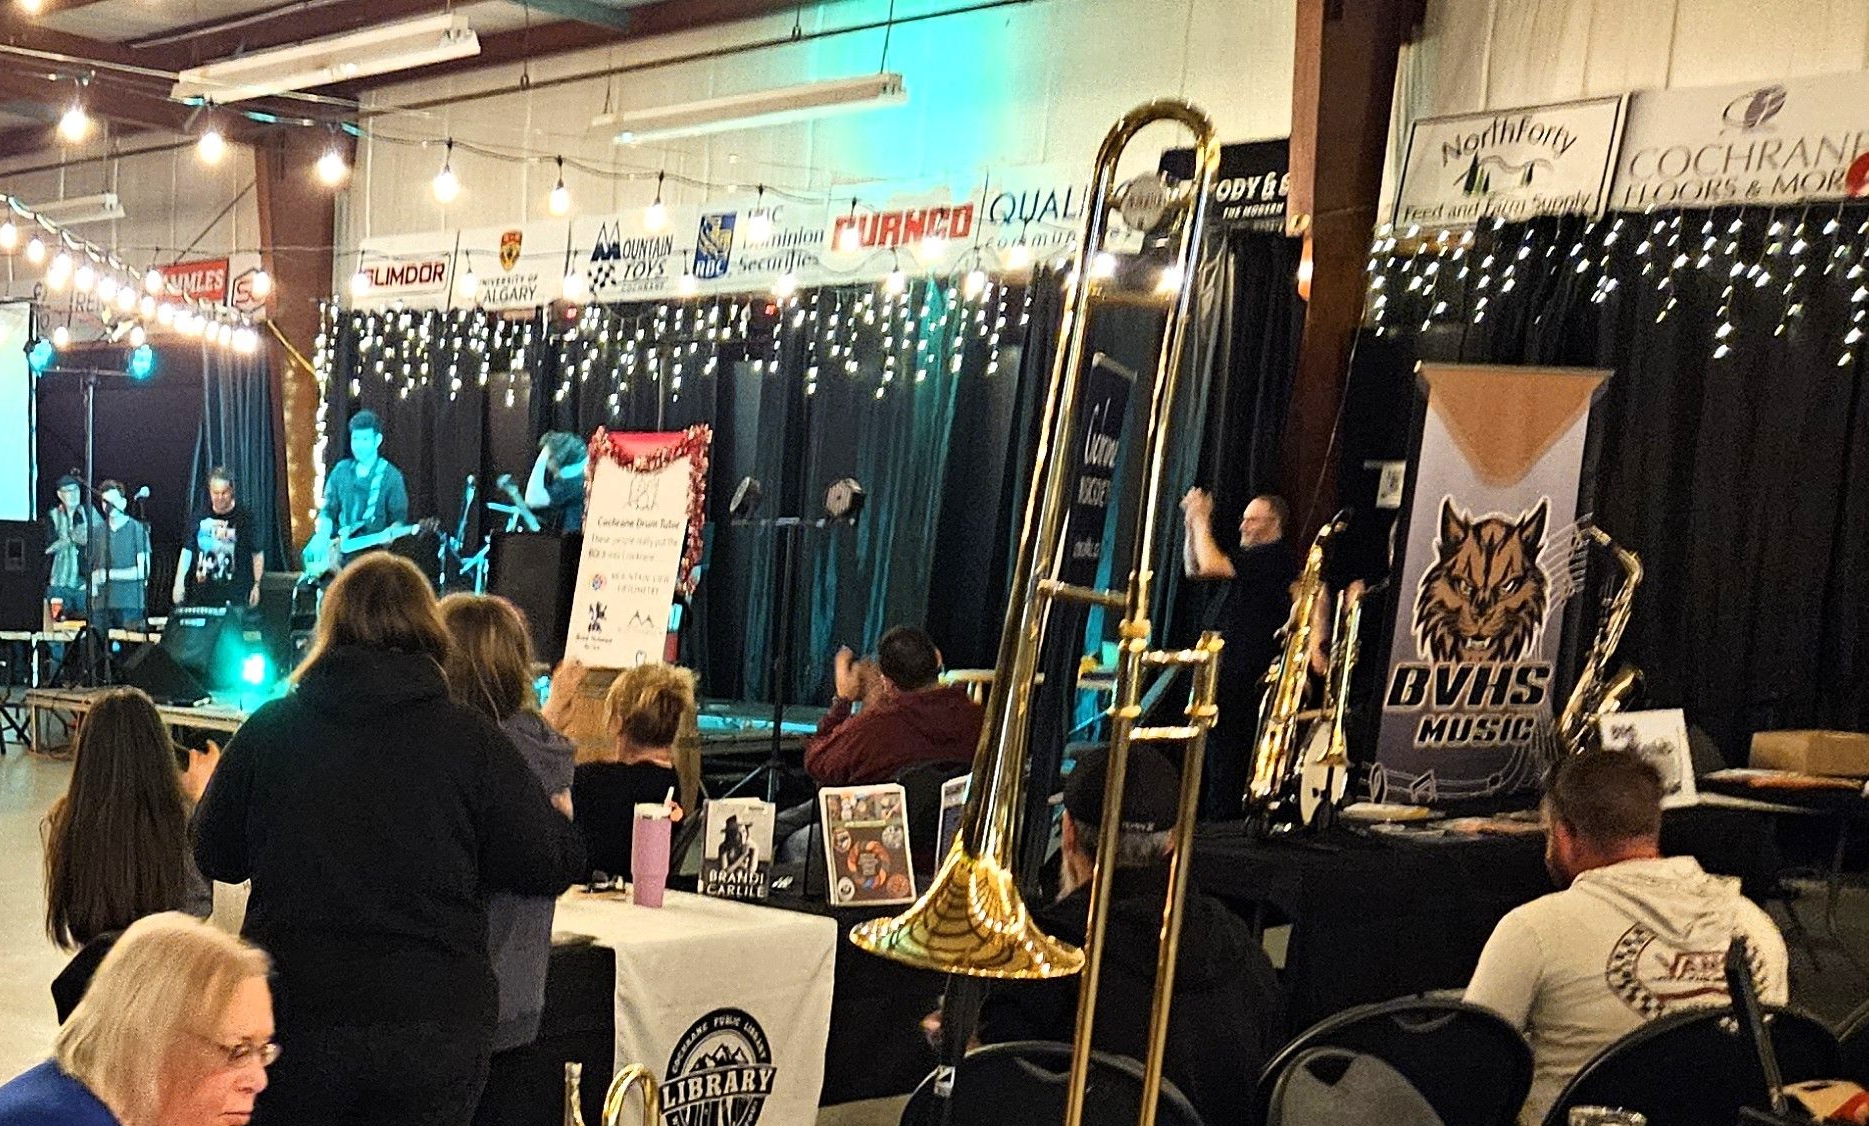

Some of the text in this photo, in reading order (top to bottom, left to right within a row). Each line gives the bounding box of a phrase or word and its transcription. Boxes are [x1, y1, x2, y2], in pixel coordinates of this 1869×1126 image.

[1210, 176, 1263, 202] ODY
[1745, 181, 1762, 198] &
[1771, 168, 1846, 195] MOR
[989, 185, 1101, 223] QUALI
[1404, 204, 1442, 222] Feed
[1448, 201, 1479, 220] and
[1534, 190, 1591, 215] Supply
[479, 274, 525, 287] NIVERSITY
[623, 260, 665, 279] TOYS
[483, 284, 539, 303] ALGARY
[1385, 665, 1549, 709] BVHS
[1416, 715, 1537, 744] MUSIC
[706, 883, 766, 898] CARLILE
[708, 868, 764, 886] BRANDI
[672, 1021, 708, 1074] COCHRANE
[713, 1014, 742, 1029] PUBLIC
[662, 1068, 774, 1111] LIBRARY
